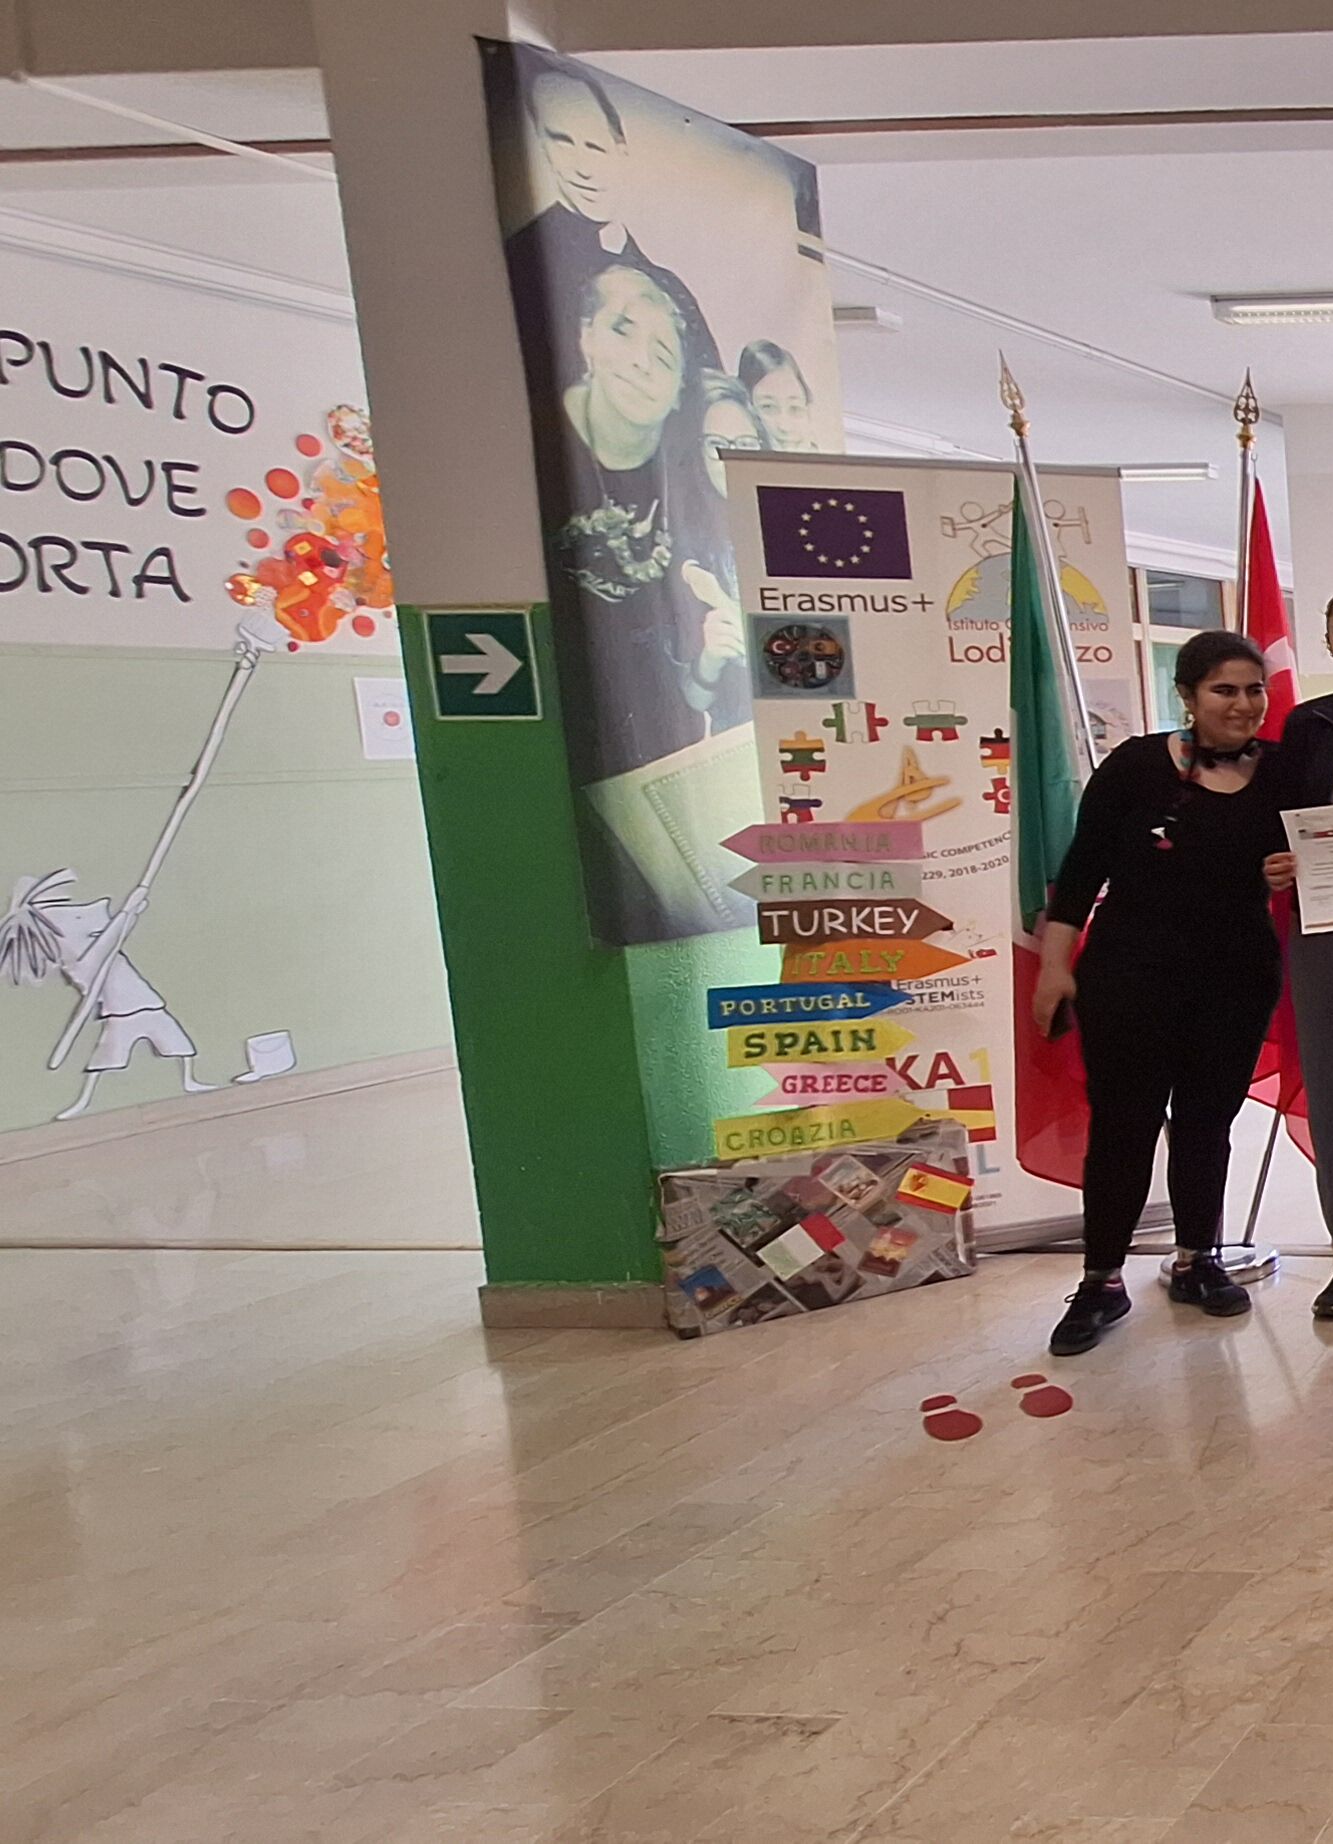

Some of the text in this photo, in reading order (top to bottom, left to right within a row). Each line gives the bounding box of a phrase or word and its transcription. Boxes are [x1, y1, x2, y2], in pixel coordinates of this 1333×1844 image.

[759, 587, 935, 613] Erasmus+
[948, 617, 1000, 632] Istituto
[759, 831, 893, 855] ROMANIA
[949, 855, 1010, 879] 2018-2020
[762, 870, 895, 894] FRANCIA
[761, 906, 920, 937] TURKEY
[791, 949, 905, 976] ITALY
[720, 992, 871, 1016] PORTUGAL
[744, 1028, 877, 1059] SPAIN
[781, 1074, 889, 1094] GREECE
[726, 1119, 857, 1151] CROAZIA
